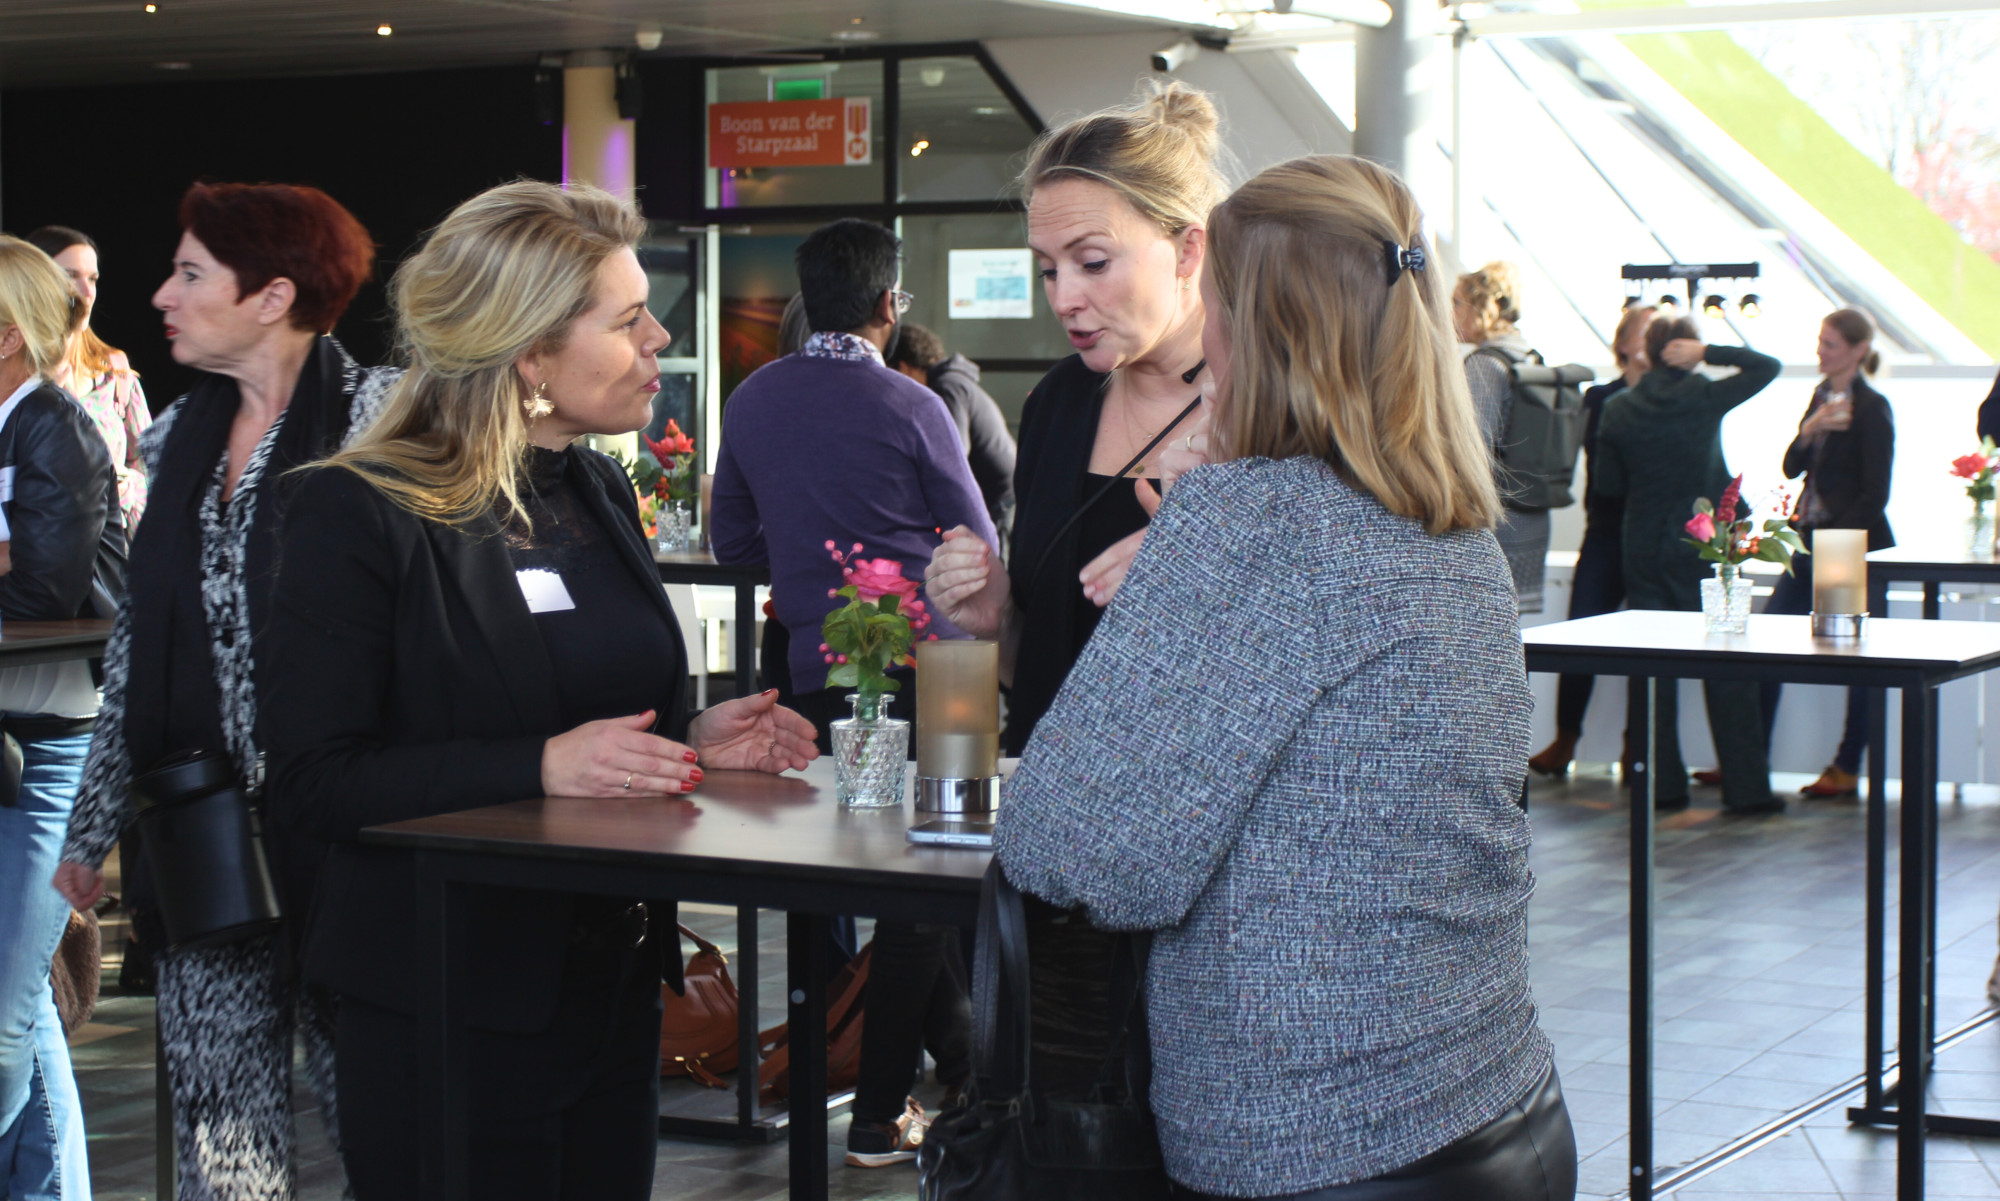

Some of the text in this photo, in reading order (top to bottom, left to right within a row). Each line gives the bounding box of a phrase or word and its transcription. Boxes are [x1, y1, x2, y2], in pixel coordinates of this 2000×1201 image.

[720, 112, 836, 133] Boon van der
[736, 133, 818, 156] Starpzaal
